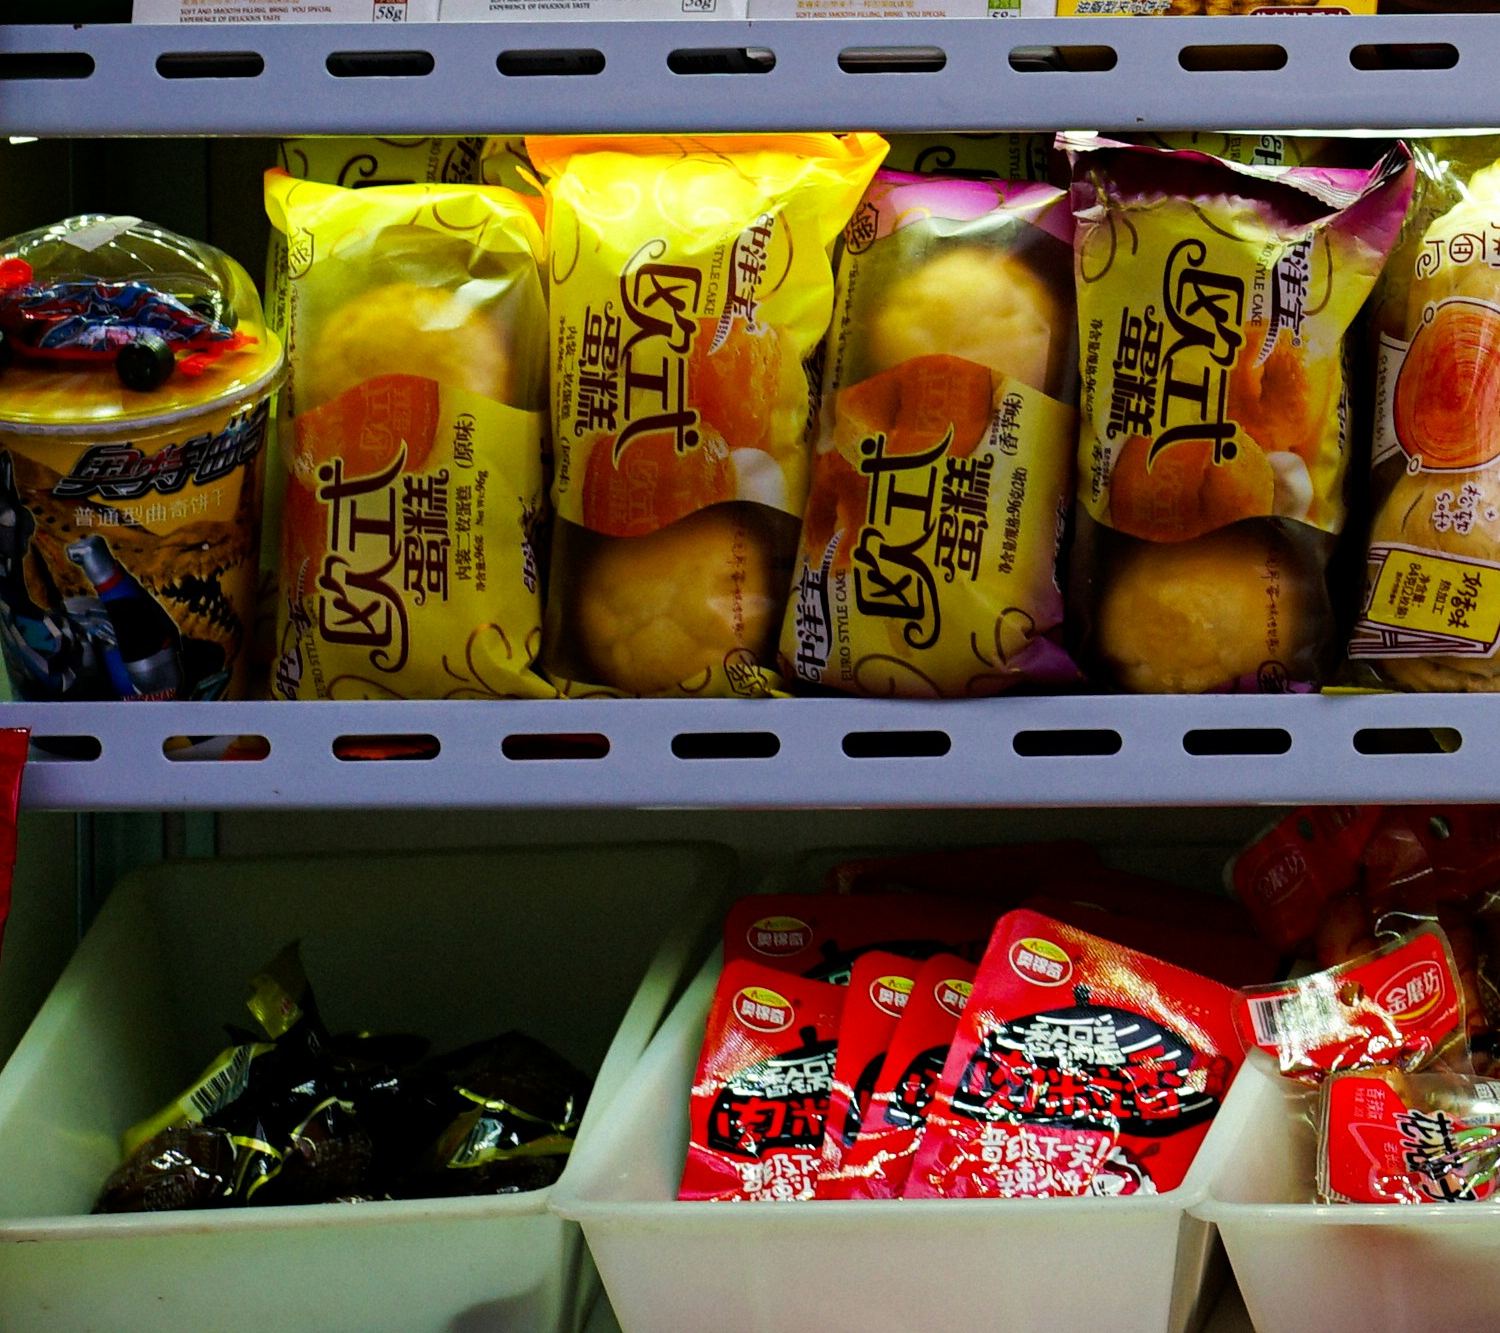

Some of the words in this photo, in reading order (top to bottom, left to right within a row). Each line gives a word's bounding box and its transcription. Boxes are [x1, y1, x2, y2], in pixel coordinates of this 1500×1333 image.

[375, 5, 404, 21] 58g
[74, 490, 225, 527] 普通型曲奇饼干
[319, 438, 409, 649] 欧式
[404, 468, 450, 605] 蛋糕
